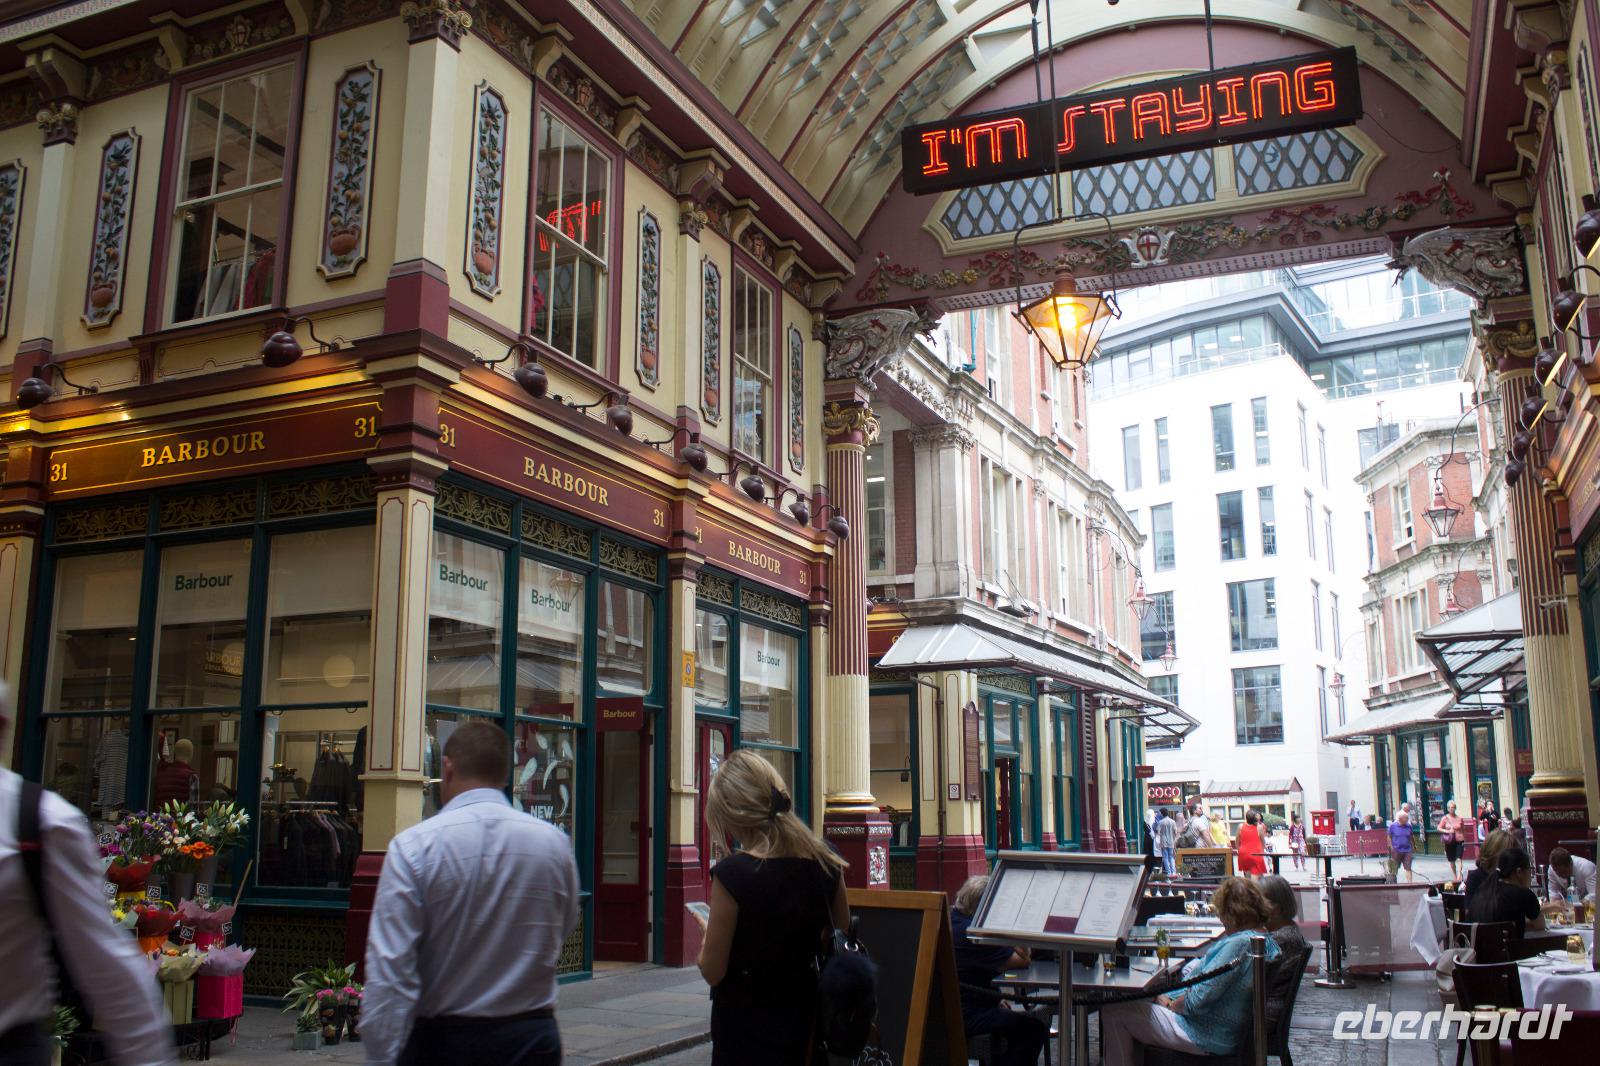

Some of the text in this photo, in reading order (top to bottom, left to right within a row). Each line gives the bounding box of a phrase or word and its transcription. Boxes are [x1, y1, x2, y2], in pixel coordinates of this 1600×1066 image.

[921, 61, 1337, 176] I'M STAYING
[355, 417, 377, 438] 31
[439, 423, 456, 448] 31
[141, 430, 265, 468] BARBOUR
[50, 462, 68, 482] 31
[522, 456, 610, 506] BARBOUR
[653, 508, 665, 528] 31
[728, 540, 782, 575] BARBOUR
[175, 572, 233, 592] Barbour
[439, 564, 488, 592] Barbour
[799, 570, 807, 585] 31
[531, 588, 572, 614] Barbour
[757, 650, 781, 667] Barbour
[603, 708, 637, 719] Barbour
[1147, 786, 1181, 799] COCO
[531, 805, 554, 820] NEW
